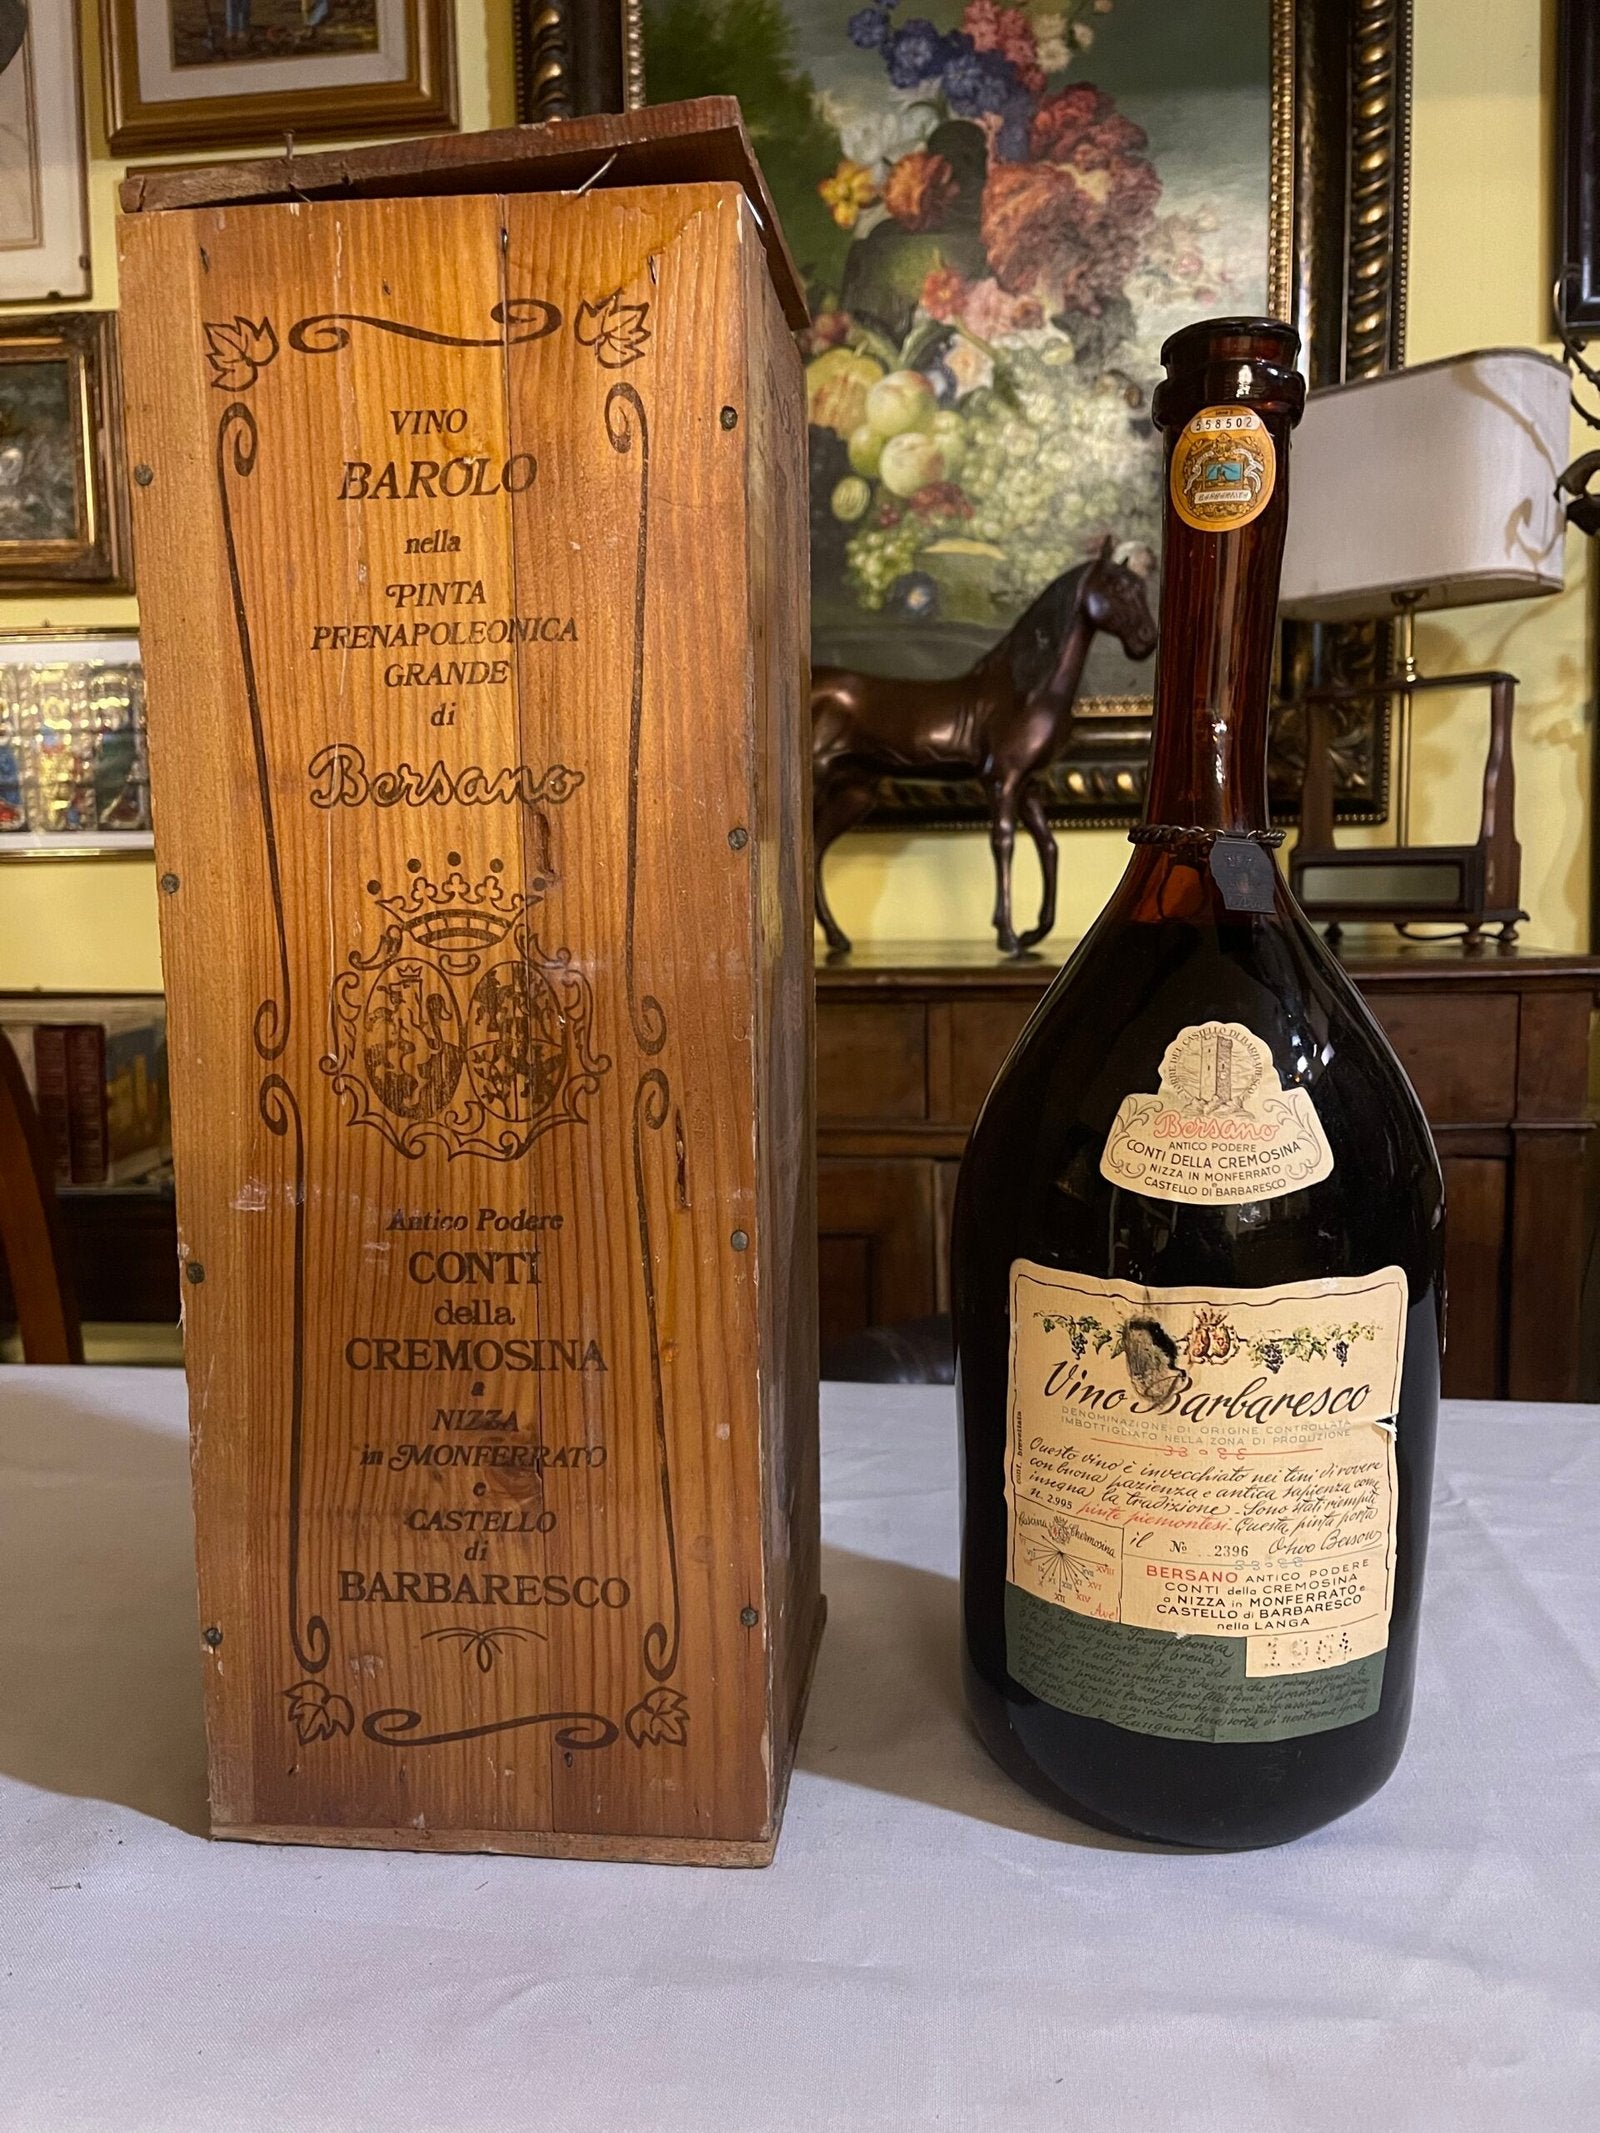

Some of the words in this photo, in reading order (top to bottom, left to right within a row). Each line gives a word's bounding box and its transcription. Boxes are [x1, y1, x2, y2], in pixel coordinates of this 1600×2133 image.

[390, 408, 467, 435] VINO
[1196, 417, 1252, 431] 558502
[338, 453, 538, 500] BAROLO
[403, 530, 461, 555] nella
[385, 580, 486, 608] PINTA
[311, 617, 579, 650] PRENAPOLEONICA
[384, 659, 510, 688] GRANDE
[430, 703, 456, 727] di
[309, 743, 585, 809] Bersano
[1183, 1027, 1227, 1046] CASTELLO
[1170, 1047, 1182, 1064] DEL
[1241, 1036, 1263, 1094] BARBARESCO
[1169, 1065, 1184, 1094] TORRE
[1154, 1109, 1280, 1142] Bersano
[1126, 1139, 1166, 1162] CONTI
[1171, 1153, 1212, 1169] DELLA
[1218, 1141, 1301, 1169] CREMOSINA
[1169, 1141, 1207, 1151] ANTICO
[1212, 1142, 1256, 1153] PODERE
[1150, 1163, 1184, 1180] NIZZA
[1188, 1171, 1200, 1181] IN
[1205, 1164, 1281, 1182] MONFERRATO
[1144, 1176, 1198, 1196] CASTELLO
[1202, 1186, 1212, 1196] DI
[1215, 1178, 1286, 1197] BARBARESCO
[386, 1208, 469, 1233] Antico
[476, 1208, 564, 1232] Podere
[408, 1251, 541, 1285] CONTI
[434, 1300, 515, 1326] della
[345, 1337, 608, 1373] CREMOSINA
[470, 1381, 485, 1397] a
[1043, 1361, 1128, 1411] Vino
[1130, 1376, 1373, 1424] Barbaresco
[432, 1408, 520, 1432] NIZZA
[1061, 1406, 1168, 1432] DENOMINAZIONE
[1177, 1425, 1191, 1434] DI
[1200, 1426, 1259, 1435] ORIGINE
[1266, 1420, 1351, 1435] CONTROLLATA
[1061, 1416, 1158, 1441] IMBOTTIGLIATO
[1164, 1434, 1203, 1444] NELLA
[1210, 1437, 1245, 1446] ZONA
[1252, 1437, 1266, 1445] DI
[1273, 1429, 1351, 1444] PRODUZIONE
[360, 1444, 382, 1467] in
[388, 1444, 608, 1472] MONFERRATO
[1029, 1436, 1077, 1461] Questo
[1081, 1454, 1124, 1471] vino
[1140, 1464, 1252, 1483] invecchiato
[1251, 1470, 1282, 1483] nei
[1284, 1466, 1318, 1483] tini
[1337, 1462, 1383, 1476] rovere
[472, 1481, 487, 1498] e
[1029, 1457, 1053, 1473] con
[1056, 1461, 1108, 1485] buona
[1106, 1475, 1201, 1499] pazienza
[1215, 1484, 1278, 1500] antica
[1282, 1482, 1351, 1503] sapienza
[1029, 1470, 1095, 1497] insegna
[1101, 1488, 1120, 1506] la
[405, 1509, 557, 1534] CASTELLO
[1075, 1502, 1127, 1521] pinte
[463, 1540, 488, 1563] di
[1129, 1531, 1155, 1549] il
[1214, 1545, 1249, 1558] 2396
[1146, 1564, 1238, 1584] BERSANO
[1245, 1572, 1300, 1584] ANTICO
[1309, 1558, 1370, 1578] PODERE
[338, 1570, 631, 1609] BARBARESCO
[1087, 1580, 1102, 1591] XVI
[1165, 1581, 1219, 1595] CONTI
[1227, 1586, 1257, 1596] della
[1262, 1573, 1358, 1595] CREMOSINA
[1177, 1595, 1226, 1608] NIZZA
[1231, 1600, 1243, 1608] in
[1249, 1584, 1358, 1608] MONFERRATO
[1156, 1604, 1238, 1619] CASTELLO
[1243, 1610, 1254, 1619] di
[1259, 1594, 1362, 1619] BARBARESCO
[1217, 1621, 1250, 1631] nella
[1254, 1617, 1310, 1631] LANGA
